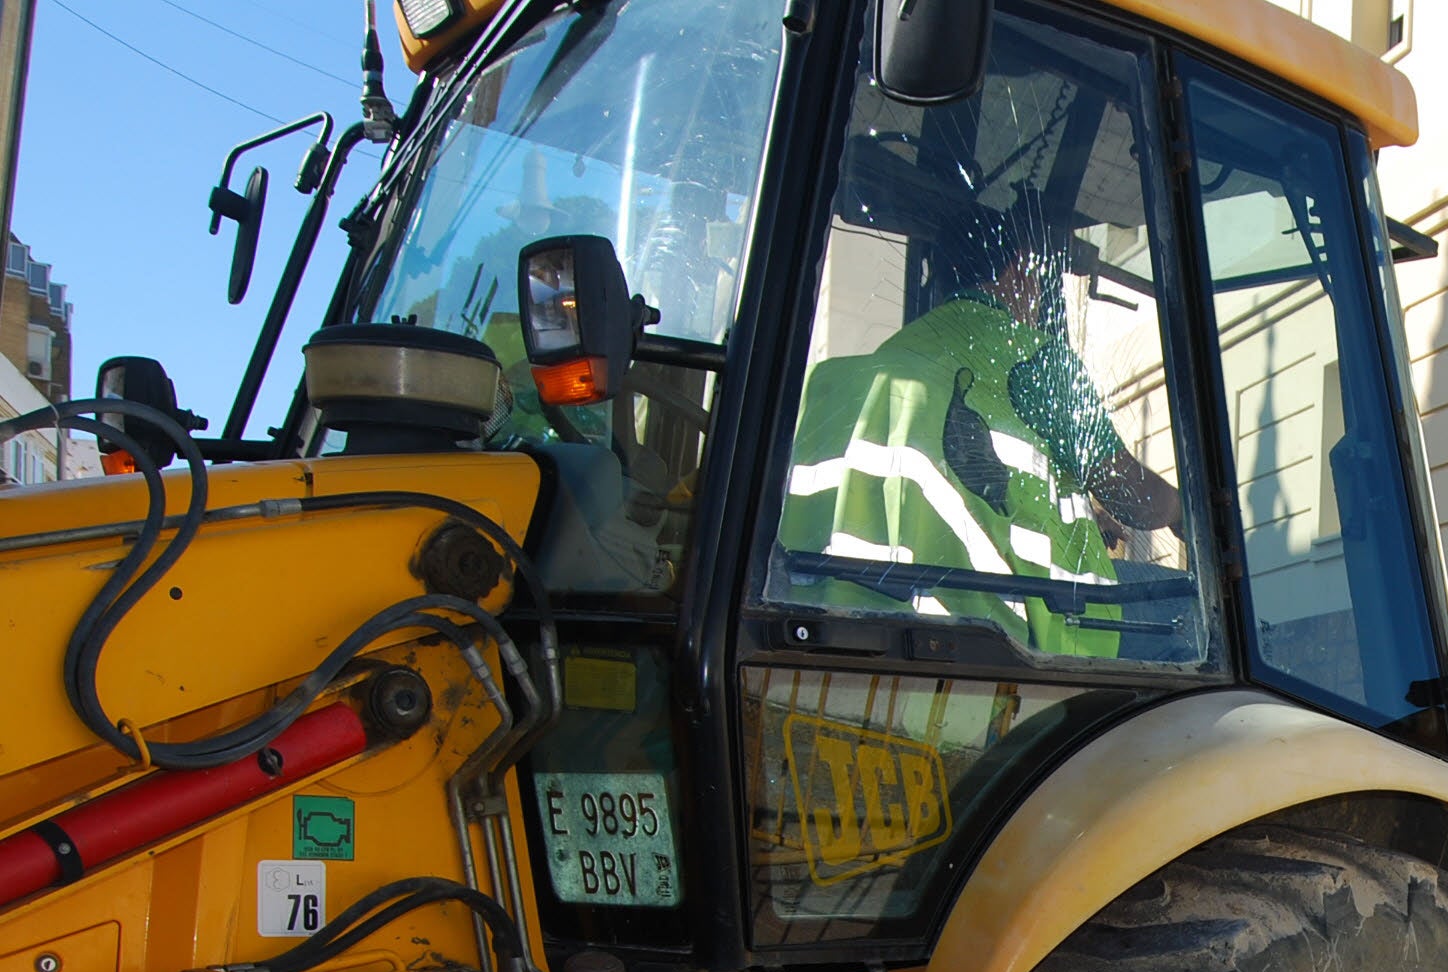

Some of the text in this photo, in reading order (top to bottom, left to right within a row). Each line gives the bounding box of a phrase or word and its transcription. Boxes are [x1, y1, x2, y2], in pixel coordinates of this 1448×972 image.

[546, 789, 660, 839] E 9895
[814, 734, 941, 866] JCB
[578, 850, 637, 896] BBV
[287, 894, 319, 931] 76
